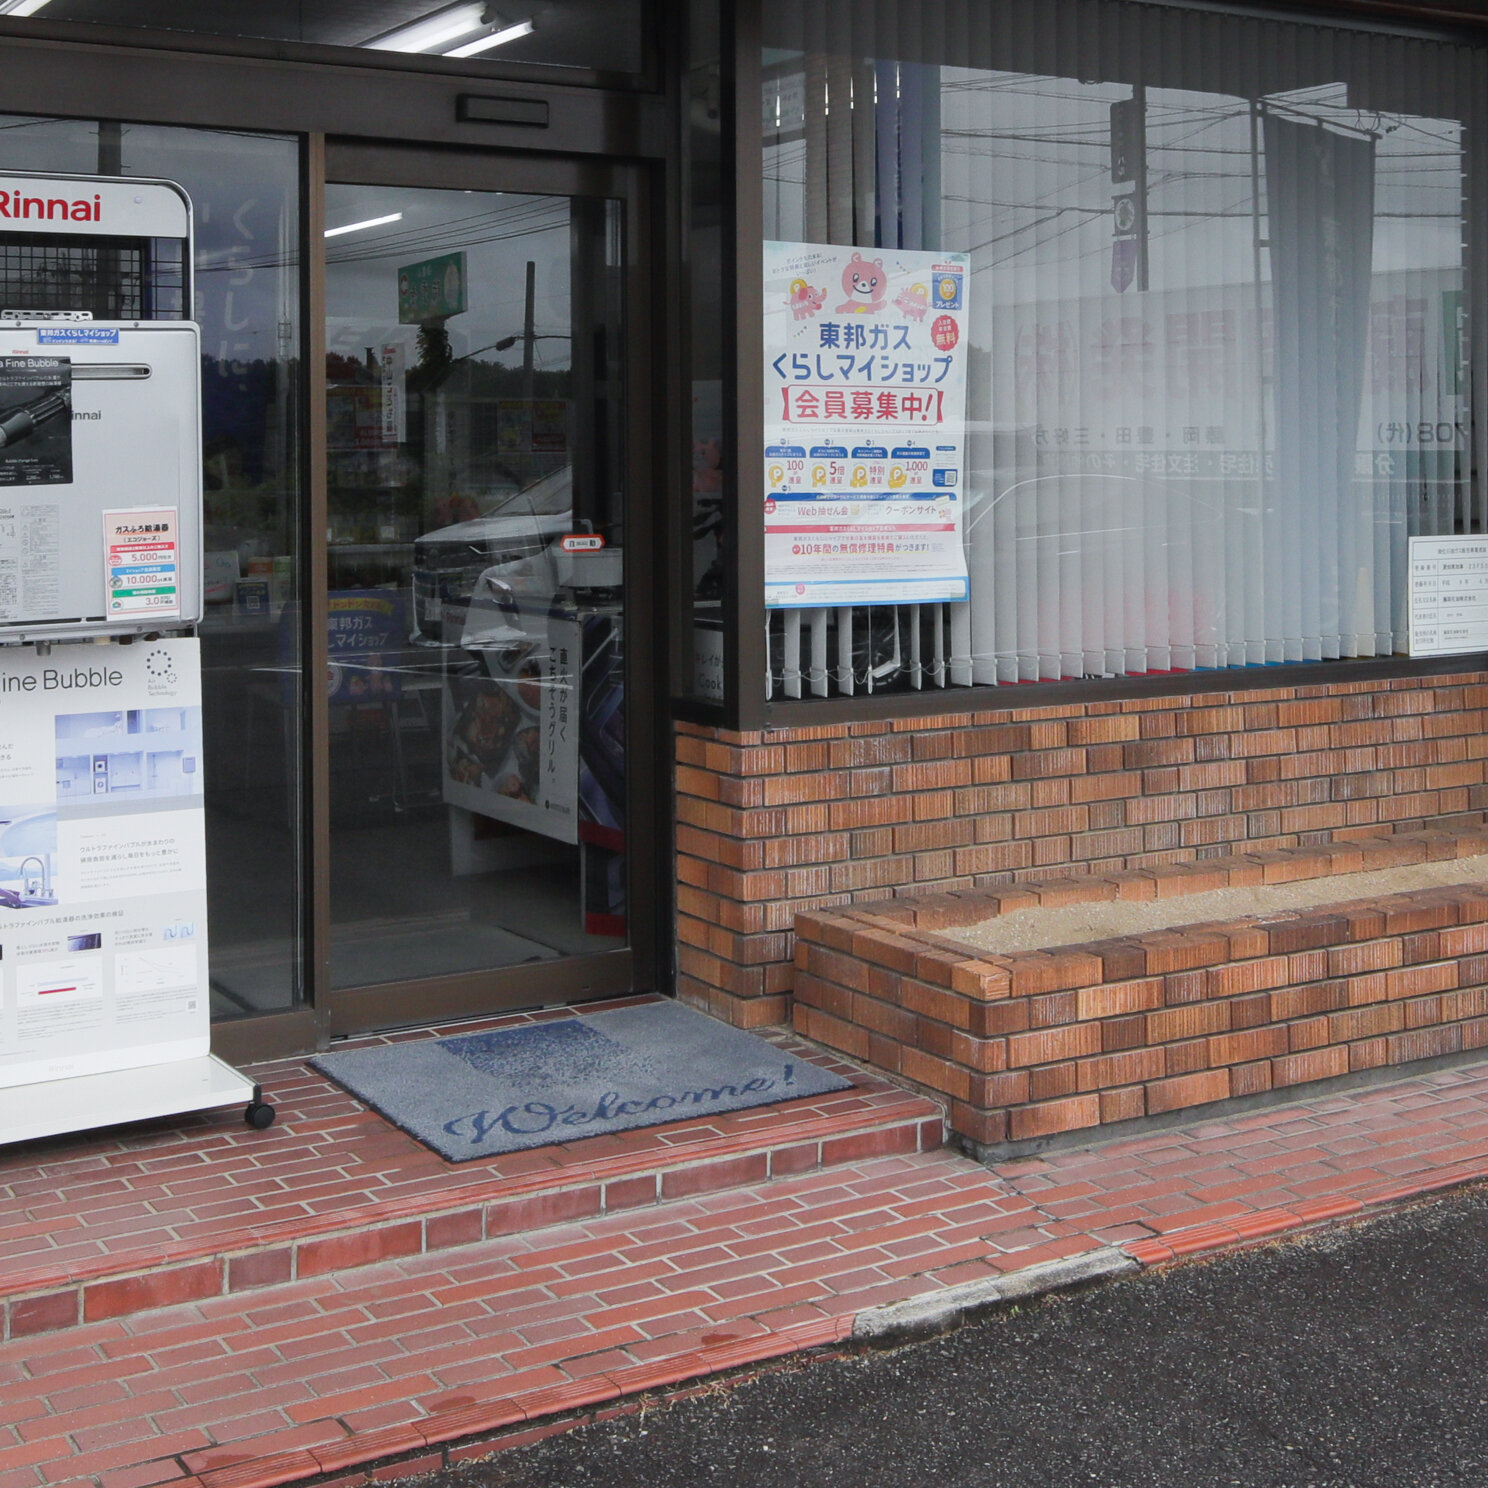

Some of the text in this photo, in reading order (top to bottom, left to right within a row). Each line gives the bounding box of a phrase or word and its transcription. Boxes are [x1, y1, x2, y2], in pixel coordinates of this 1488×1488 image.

[819, 321, 912, 350] 東邦ガス
[936, 332, 956, 345] 無料
[5, 359, 26, 368] Fine
[27, 358, 59, 367] Bubble
[772, 353, 953, 384] くらしマイショップ
[794, 389, 933, 421] 会員募集中!
[72, 410, 101, 420] innai
[787, 460, 804, 470] 100
[905, 461, 928, 472] 1,000
[115, 524, 169, 534] ガスふろ給湯器
[43, 667, 123, 690] Bubble
[443, 1063, 796, 1144] Welcome!
